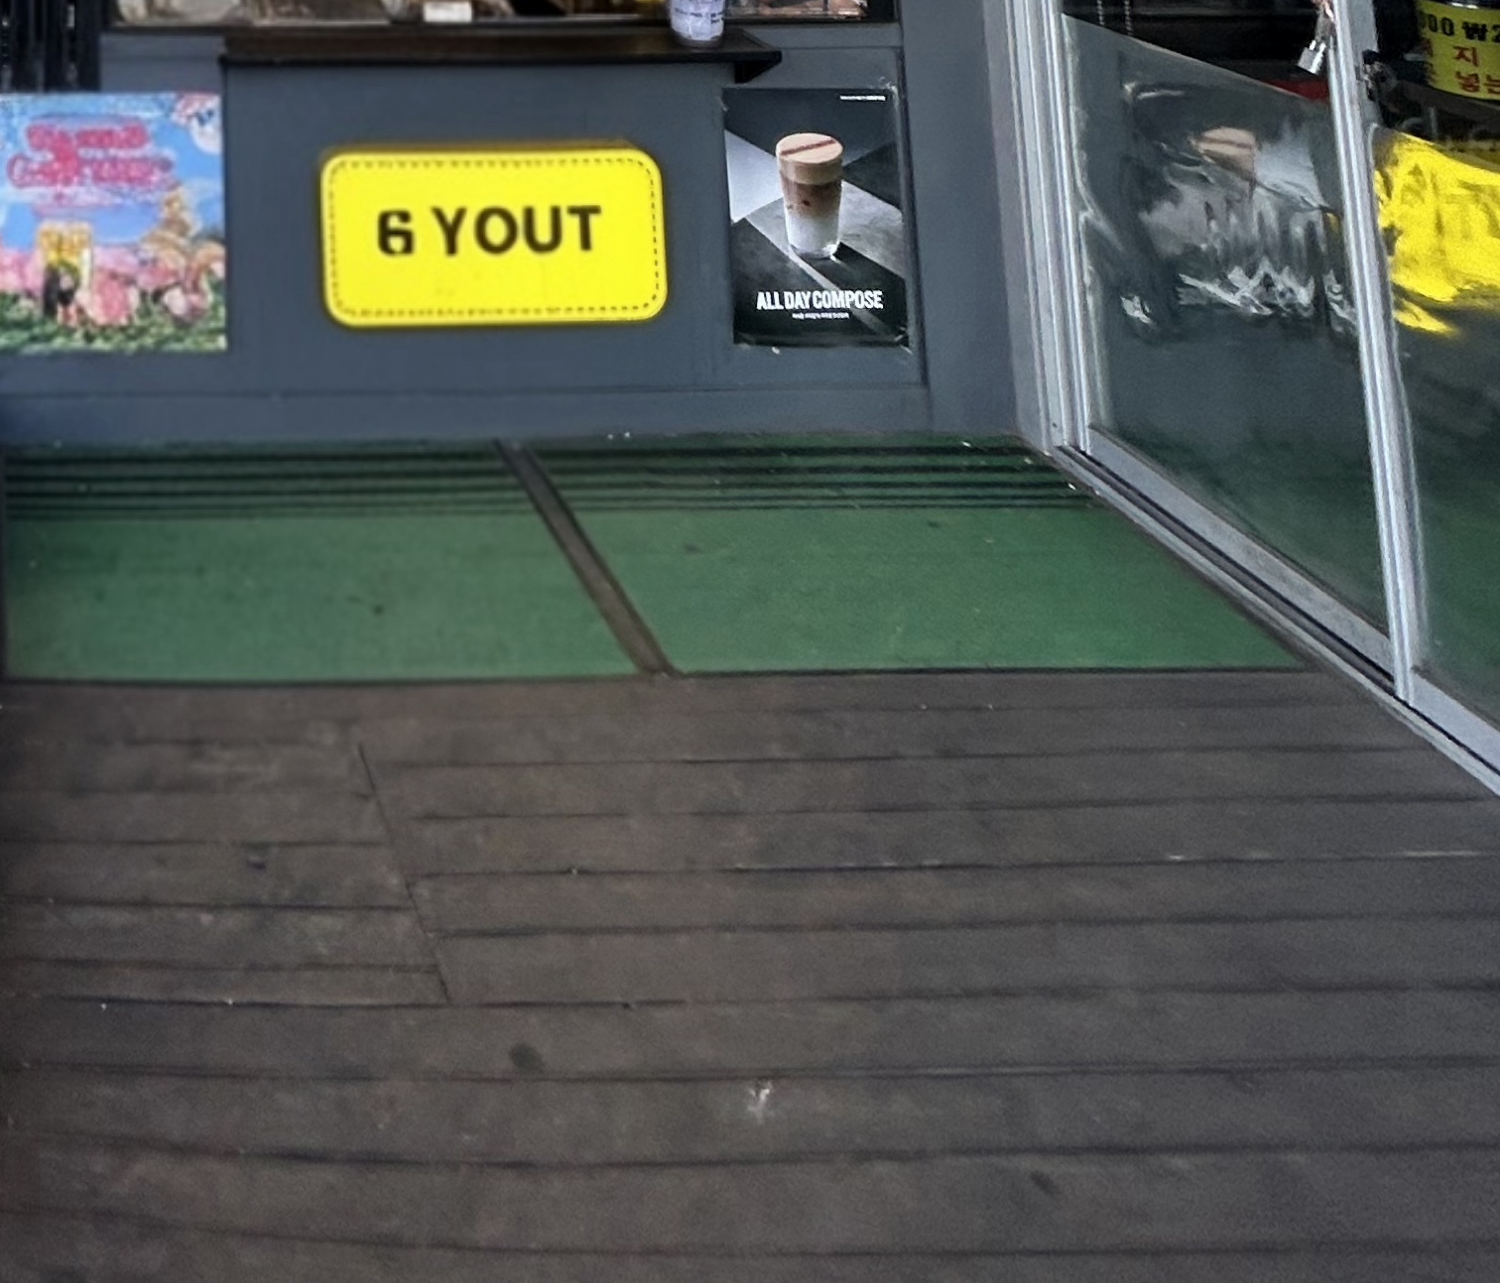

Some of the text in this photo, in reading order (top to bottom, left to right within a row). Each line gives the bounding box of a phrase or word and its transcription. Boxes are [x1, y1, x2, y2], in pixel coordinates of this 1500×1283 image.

[429, 204, 602, 257] YOUT
[756, 289, 884, 310] ALL DAY COMPOSE
